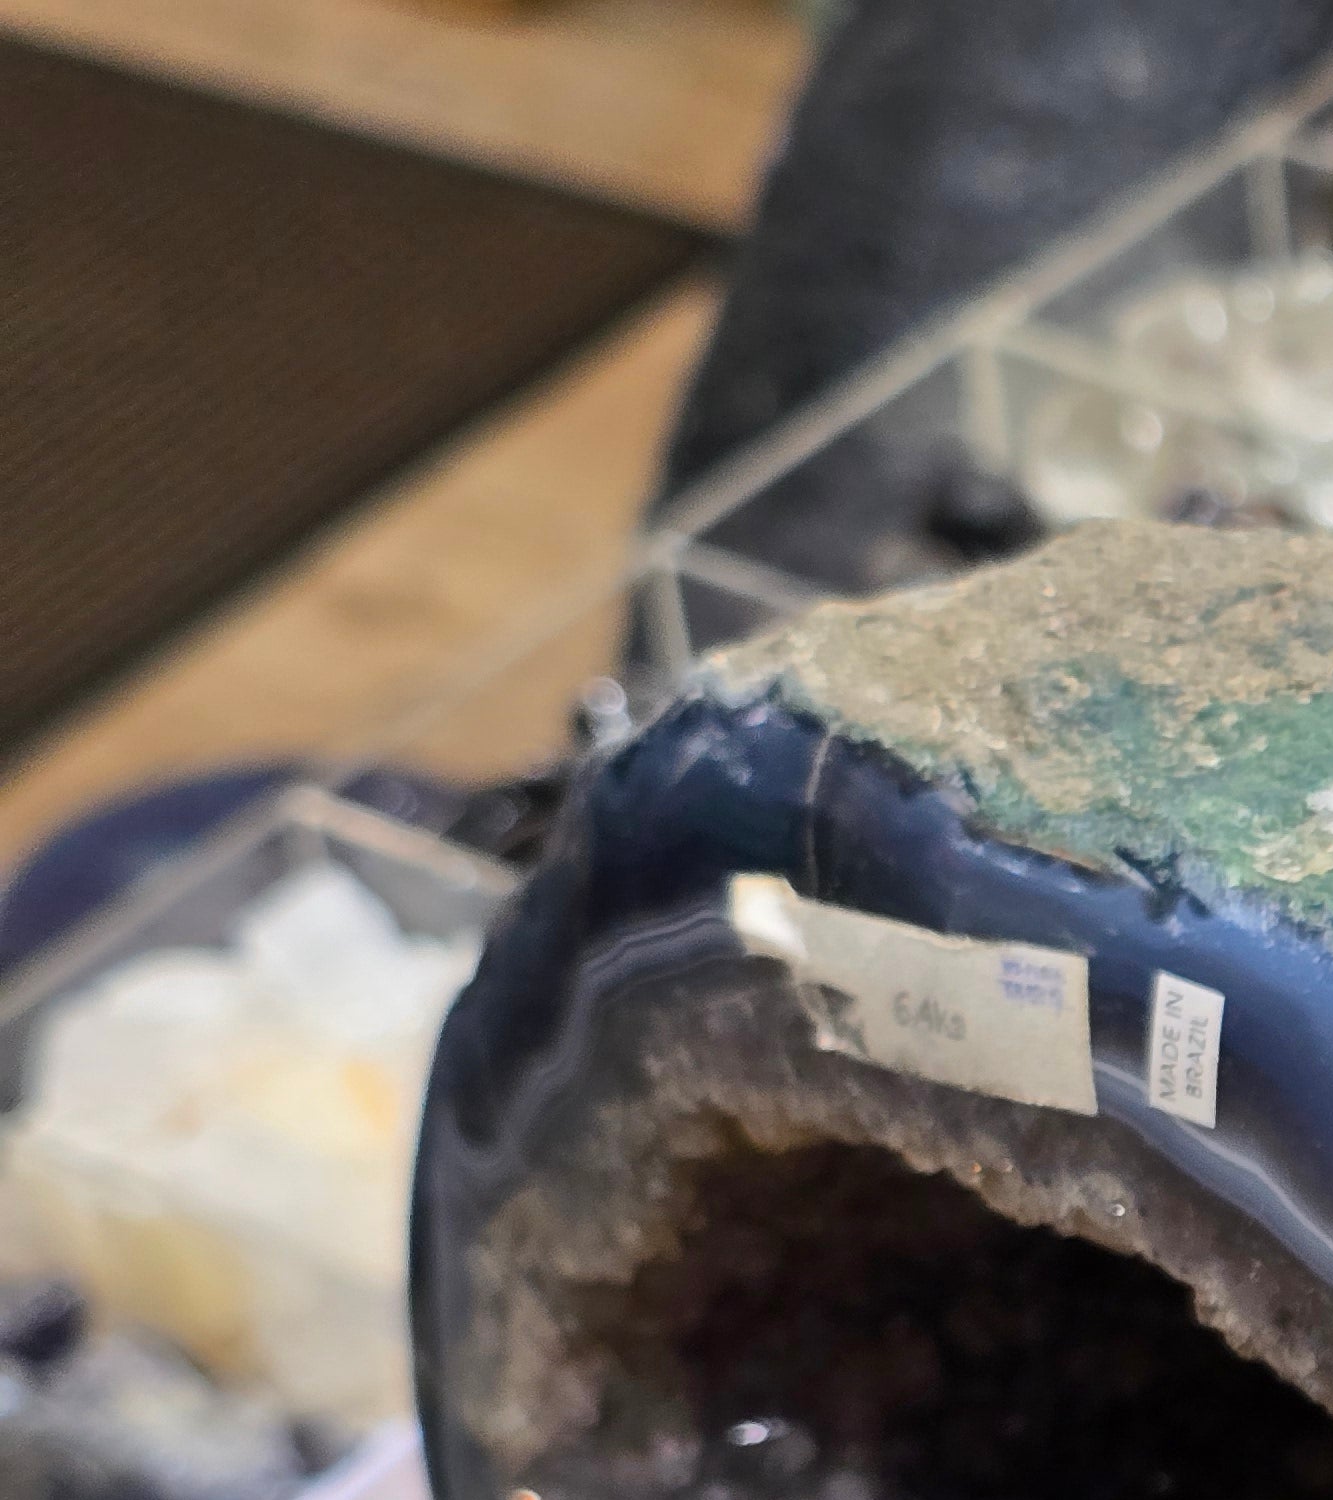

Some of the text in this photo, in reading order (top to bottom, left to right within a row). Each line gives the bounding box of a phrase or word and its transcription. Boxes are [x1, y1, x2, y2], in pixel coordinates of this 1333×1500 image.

[1159, 989, 1184, 1101] MADE IN
[1185, 1016, 1209, 1100] BRAZIL
